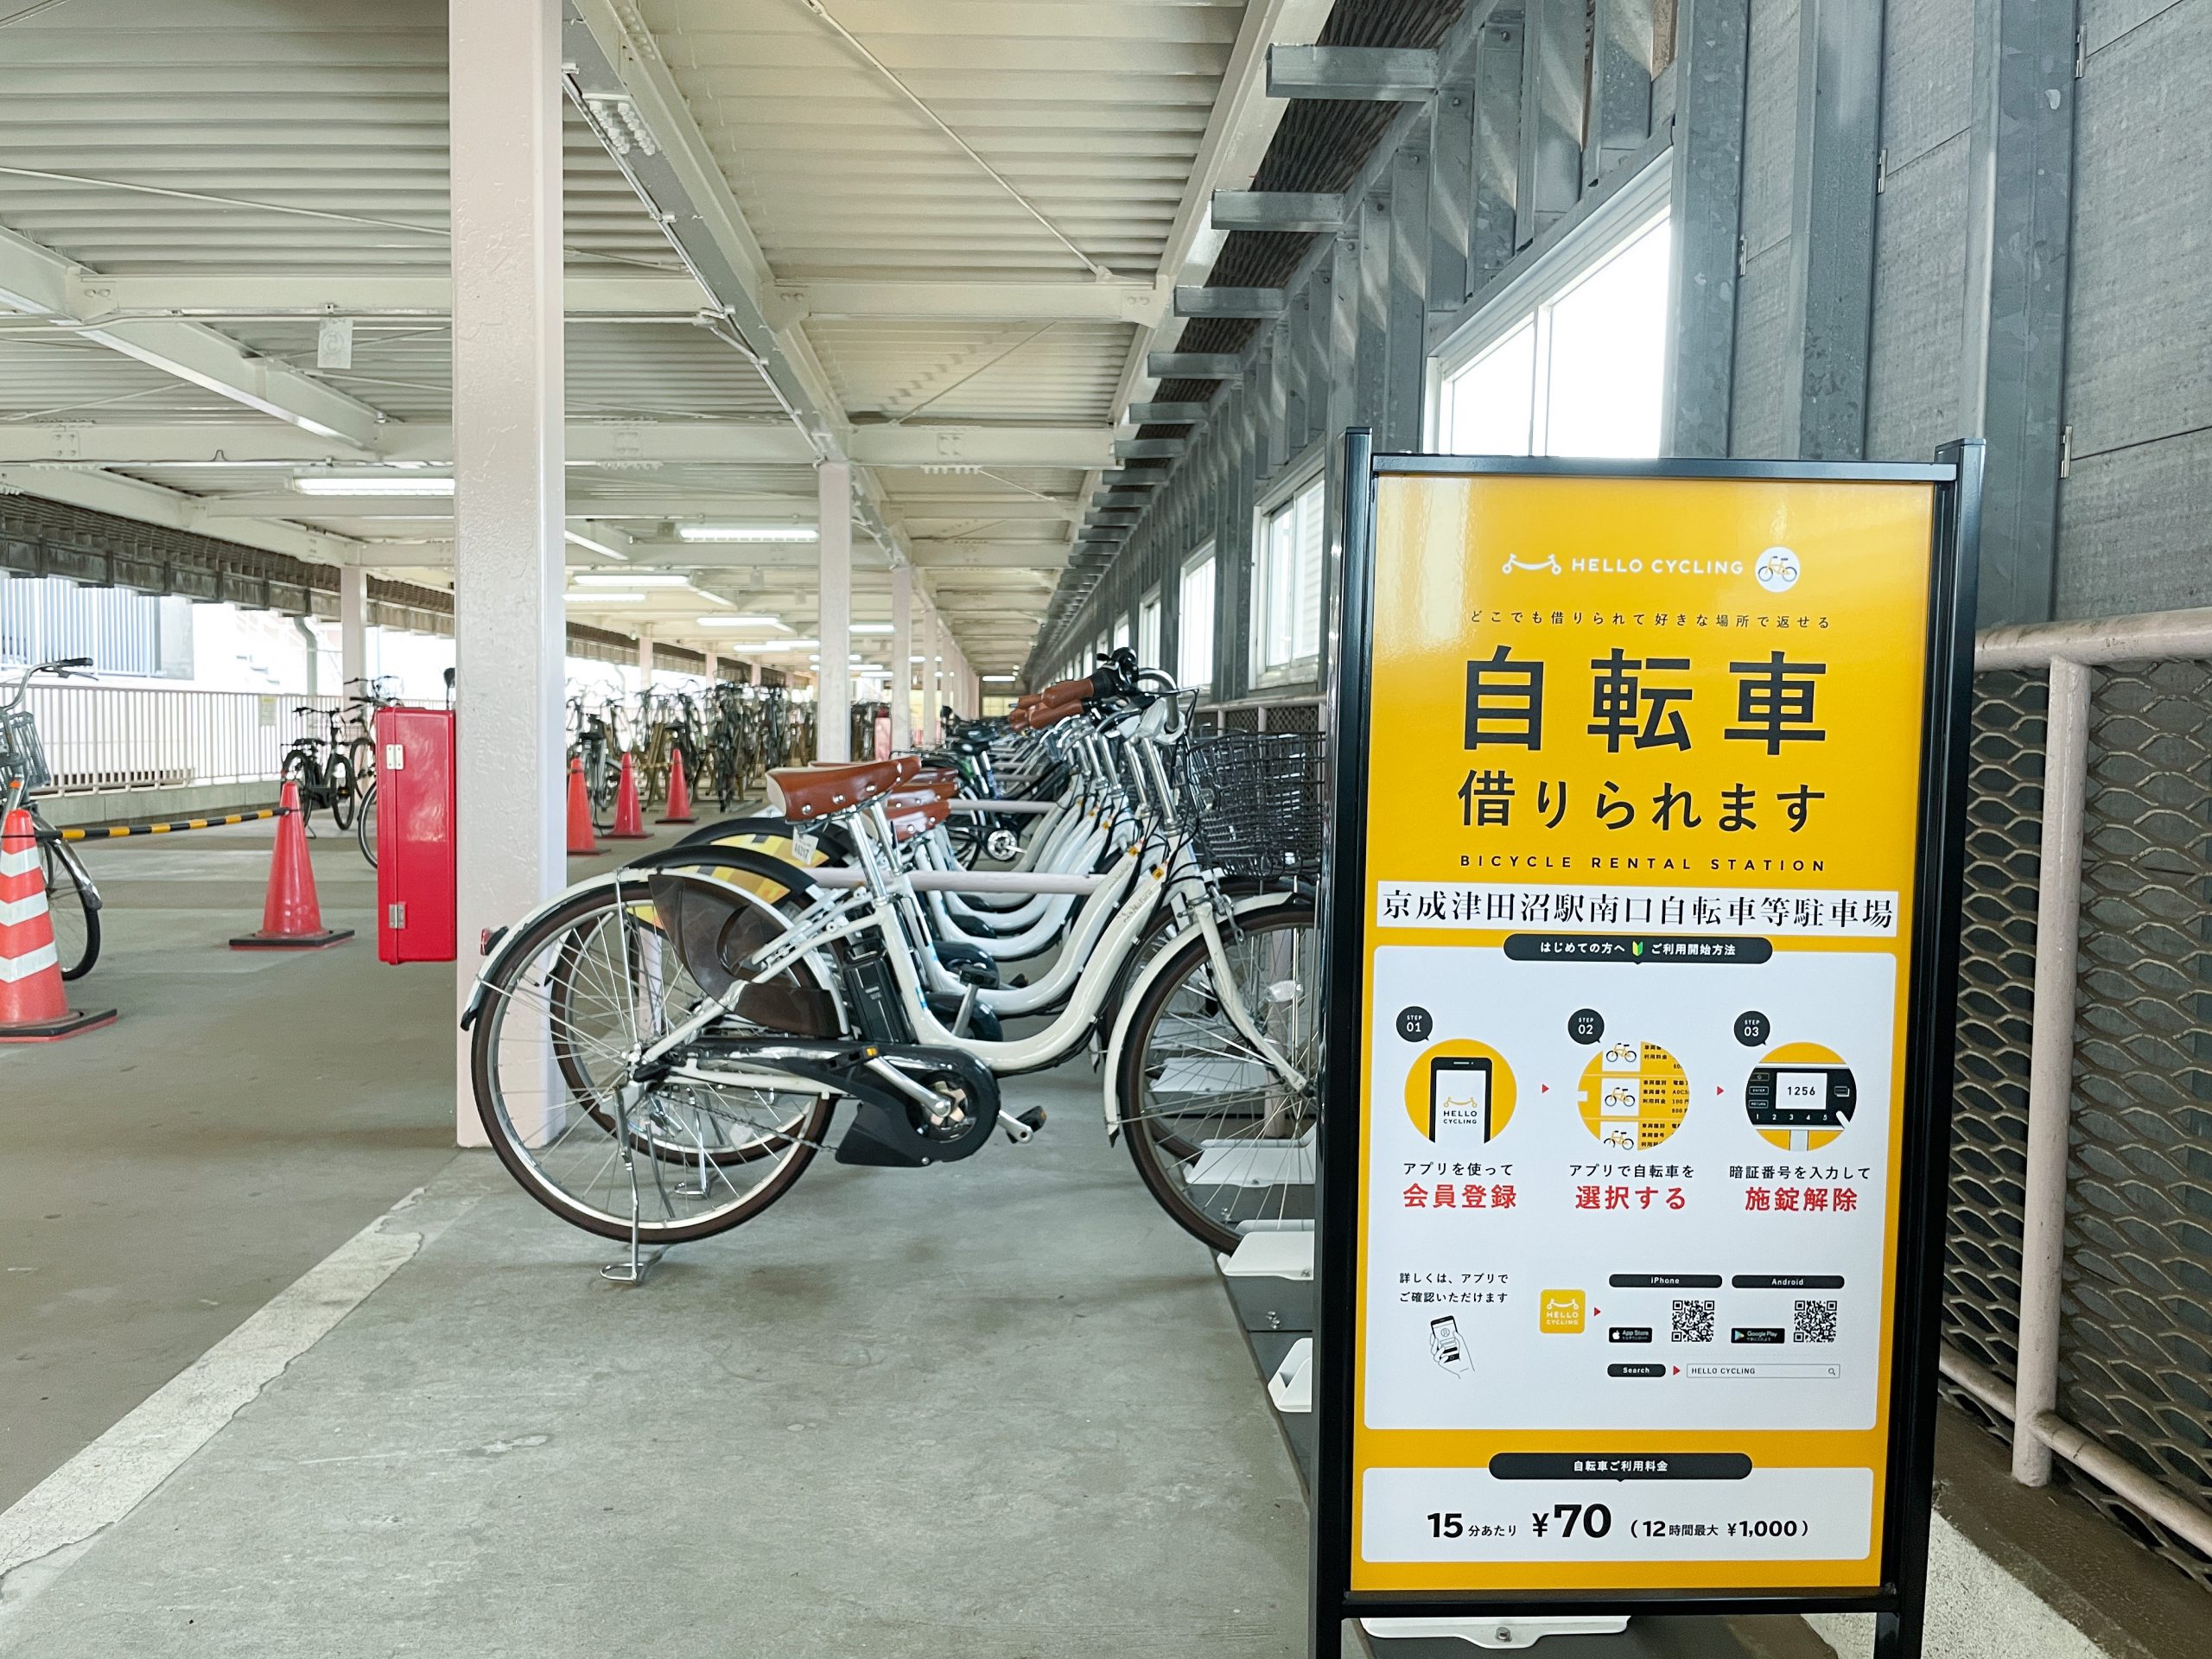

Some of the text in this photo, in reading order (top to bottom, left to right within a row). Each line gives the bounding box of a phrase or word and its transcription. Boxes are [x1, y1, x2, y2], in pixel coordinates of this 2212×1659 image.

[1572, 558, 1744, 575] HELLO CYCLING
[1470, 609, 1830, 630] どこでも借りられて好きな場所で返せる
[1464, 645, 1827, 756] 自転車
[1458, 769, 1826, 833] 借りられます
[1460, 855, 1825, 872] BICYCLE RENTAL STATION
[1382, 887, 1893, 929] 京成津田沼駅南口自転車等駐車場
[1540, 941, 1736, 957] はじめての方へ ご利用開始方法
[1406, 1021, 1421, 1033] 01
[1578, 1024, 1593, 1035] 02
[1744, 1026, 1759, 1037] 03
[1787, 1086, 1815, 1096] 1256
[1403, 1161, 1514, 1177] アプリを使って
[1569, 1163, 1695, 1179] アプリで自転車を
[1729, 1165, 1871, 1180] 暗証番号を入力して
[1402, 1182, 1517, 1210] 会員登録
[1575, 1185, 1687, 1211] 選択する
[1745, 1185, 1859, 1212] 施錠解除
[1399, 1272, 1509, 1284] 詳しくは、アプリで
[1650, 1276, 1681, 1286] iPhone
[1771, 1277, 1804, 1287] Android
[1400, 1291, 1508, 1303] ご確認いただけます
[1573, 1459, 1669, 1472] 自転車ご利用料金
[1427, 1511, 1517, 1539] 15分あたり
[1532, 1503, 1612, 1539] ¥70
